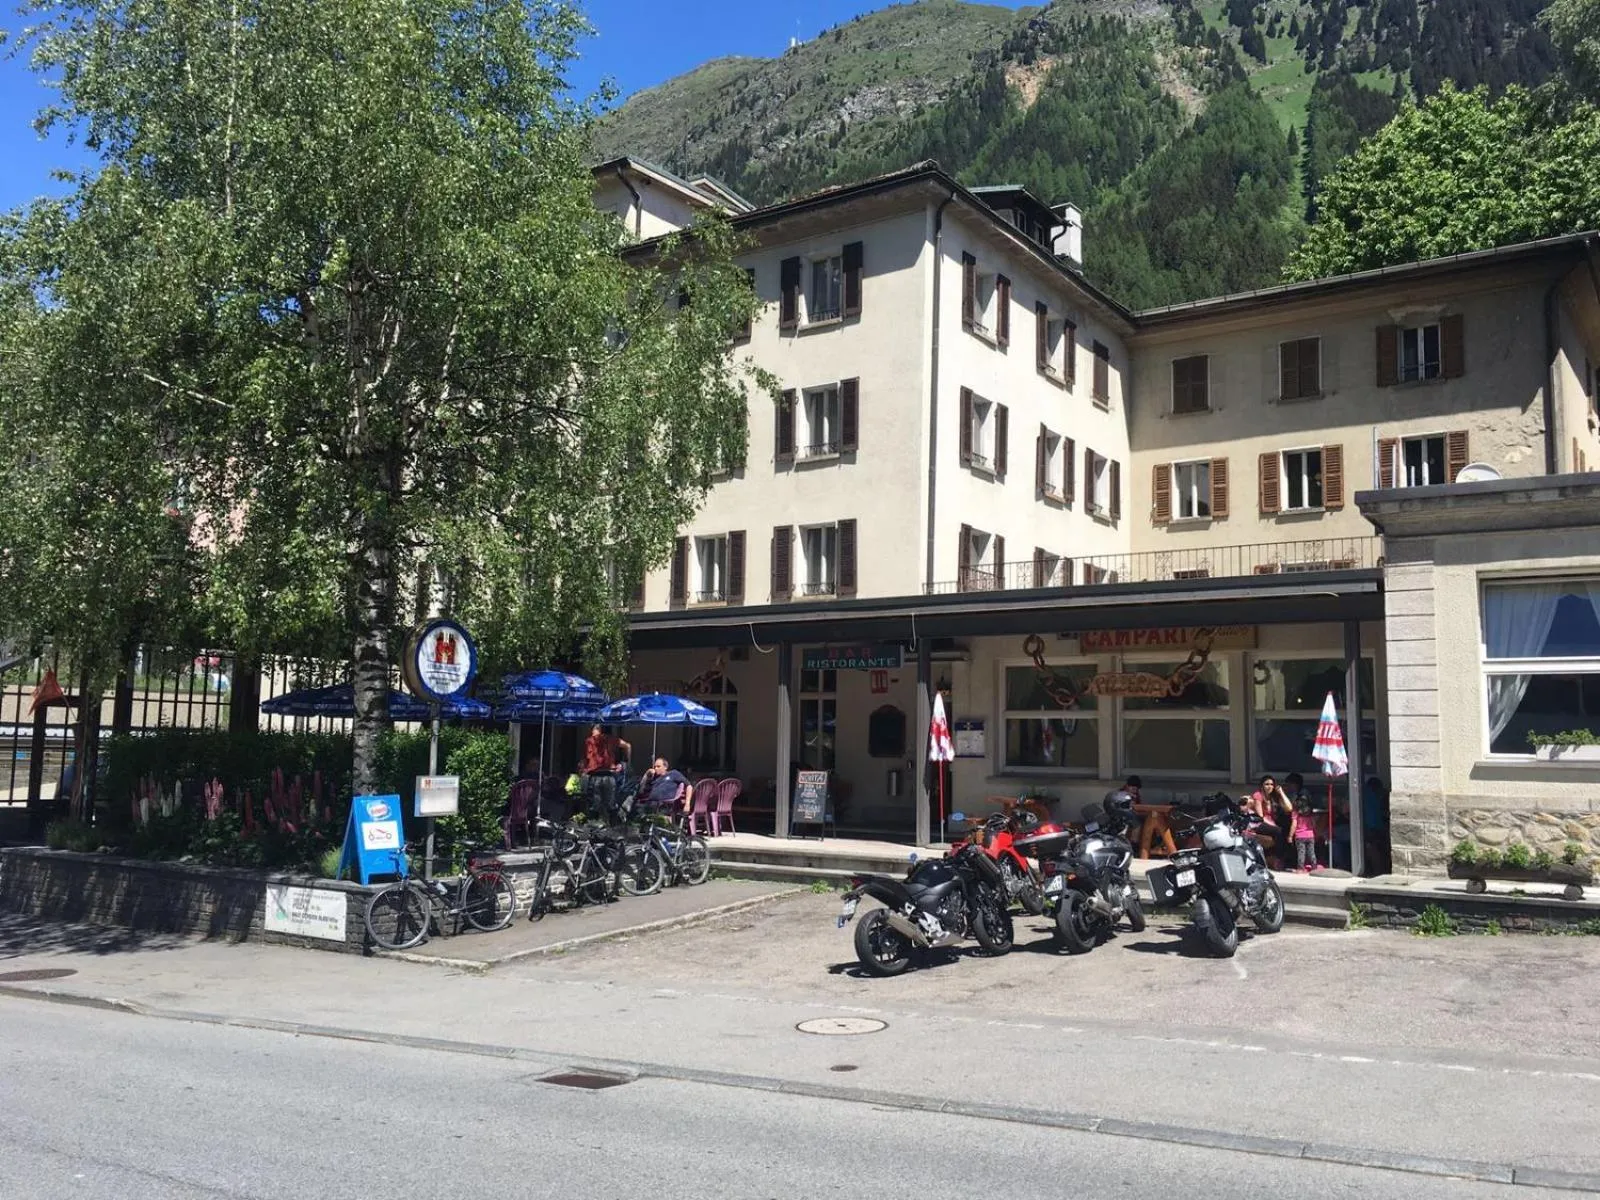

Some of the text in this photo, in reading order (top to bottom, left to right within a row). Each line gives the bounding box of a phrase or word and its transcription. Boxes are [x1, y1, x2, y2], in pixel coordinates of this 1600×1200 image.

[1083, 629, 1187, 648] CAMPARI
[828, 647, 871, 658] BAR
[807, 658, 896, 669] RISTORANTE
